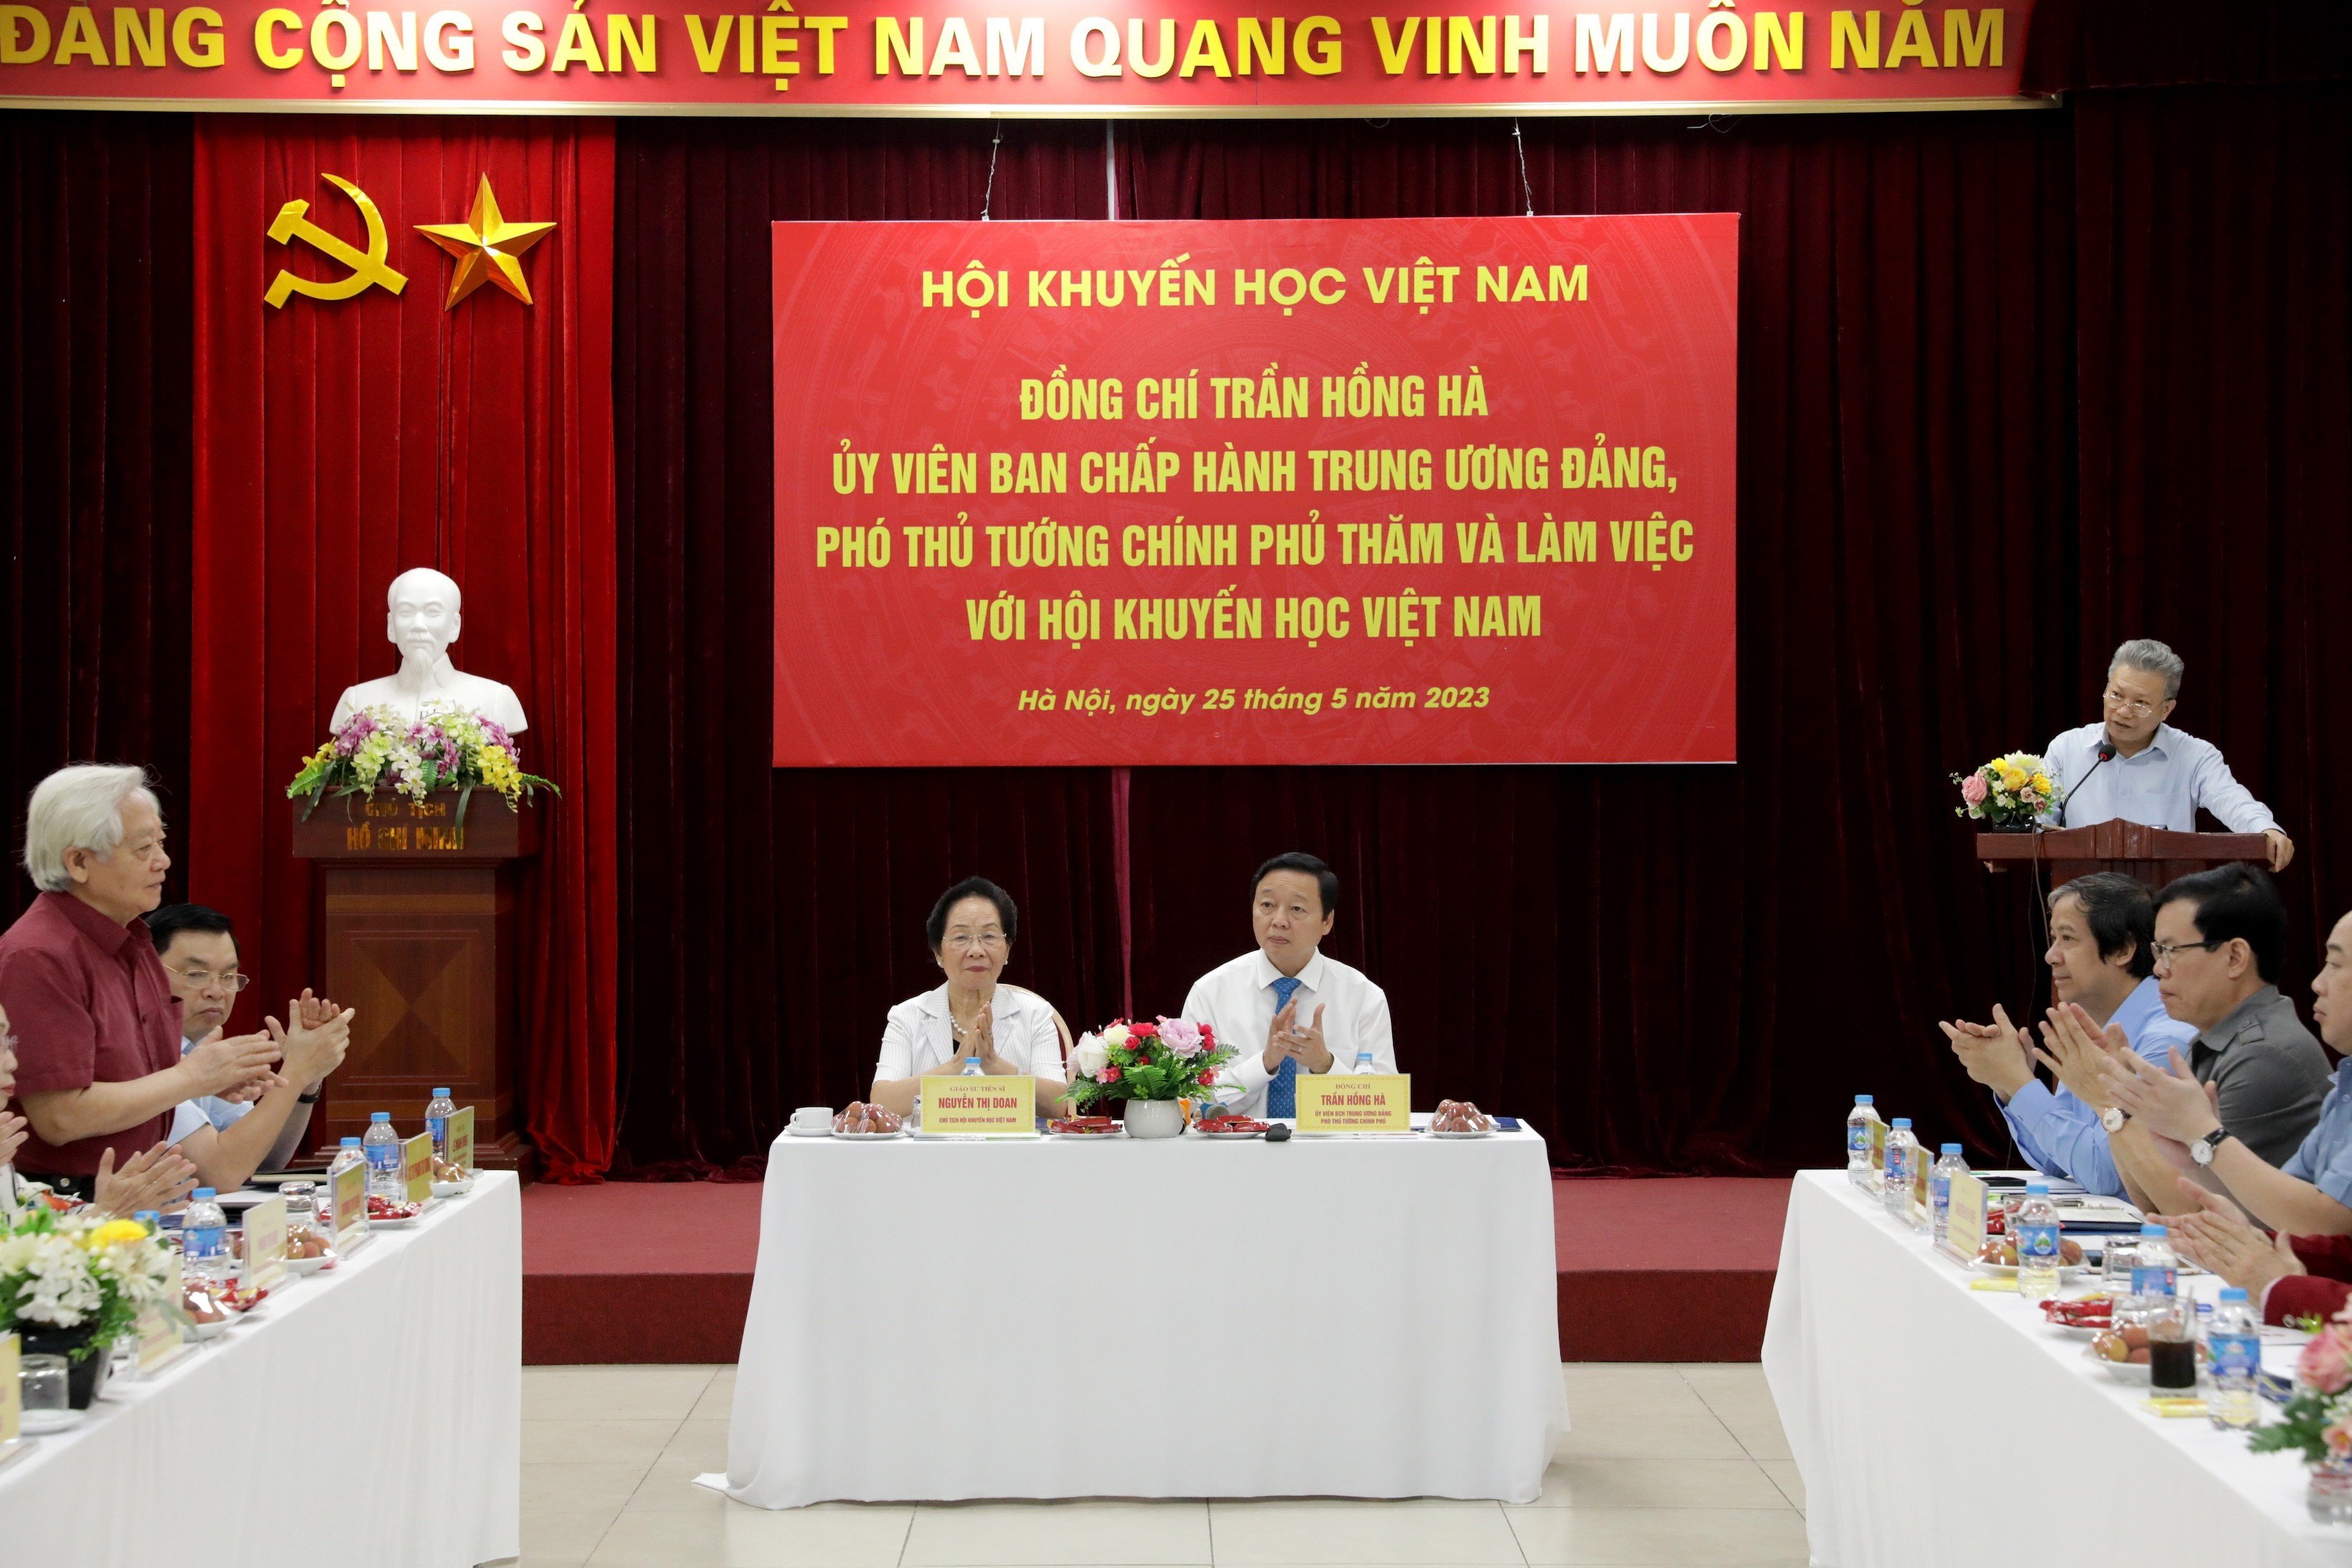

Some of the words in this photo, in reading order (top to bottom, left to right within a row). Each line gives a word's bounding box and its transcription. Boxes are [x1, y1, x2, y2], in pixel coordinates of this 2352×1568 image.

[684, 0, 848, 91] VIỆT
[875, 16, 1045, 77] NAM
[1070, 15, 1343, 78] QUANG
[1382, 12, 1549, 77] VINH
[1575, 0, 1804, 73] MUÔN
[923, 259, 1008, 318] HỘI
[1029, 252, 1215, 307] KHUYẾN
[1235, 268, 1345, 316] HỌC
[1363, 256, 1459, 314] VIỆT
[1477, 265, 1588, 302] NAM
[1020, 364, 1123, 420] ĐỒNG
[1137, 368, 1199, 420] CHÍ
[1211, 362, 1309, 419] TRẦN
[1323, 362, 1424, 418] HỒNG
[1439, 366, 1488, 417] HÀ
[833, 438, 879, 494] ỦY
[892, 444, 976, 494] VIÊN
[991, 452, 1067, 493] BAN
[1081, 437, 1180, 493] CHẤP
[1194, 442, 1296, 492] HÀNH
[1308, 449, 1432, 491] TRUNG
[1446, 445, 1549, 491] ƯƠNG
[1561, 433, 1677, 493] ĐẢNG,
[816, 518, 890, 568] PHÓ
[904, 512, 973, 567] THỦ
[986, 516, 1108, 567] TƯỚNG
[1123, 516, 1237, 566] CHÍNH
[1251, 510, 1325, 565] PHỦ
[1338, 514, 1443, 564] THĂM
[1457, 514, 1504, 563] VÀ
[1518, 513, 1597, 563] LÀM
[1610, 512, 1694, 571] VIỆC
[967, 590, 1025, 640] VỚI
[1040, 590, 1100, 649] HỘI
[1114, 584, 1261, 640] KHUYẾN
[1276, 597, 1350, 648] HỌC
[1363, 588, 1441, 647] VIỆT
[1455, 596, 1541, 637] NAM
[1018, 688, 1056, 711] Hà
[1065, 689, 1115, 716] Nội,
[1126, 688, 1195, 716] ngày
[1203, 689, 1235, 709] 25
[1244, 687, 1323, 715] tháng
[1331, 688, 1347, 709] 5
[1356, 687, 1416, 709] năm
[1424, 687, 1490, 708] 2023
[938, 1093, 974, 1108] NGUYỄN
[976, 1097, 990, 1111] THỊ
[993, 1097, 1018, 1108] DOAN
[1374, 1092, 1386, 1105] HÀ
